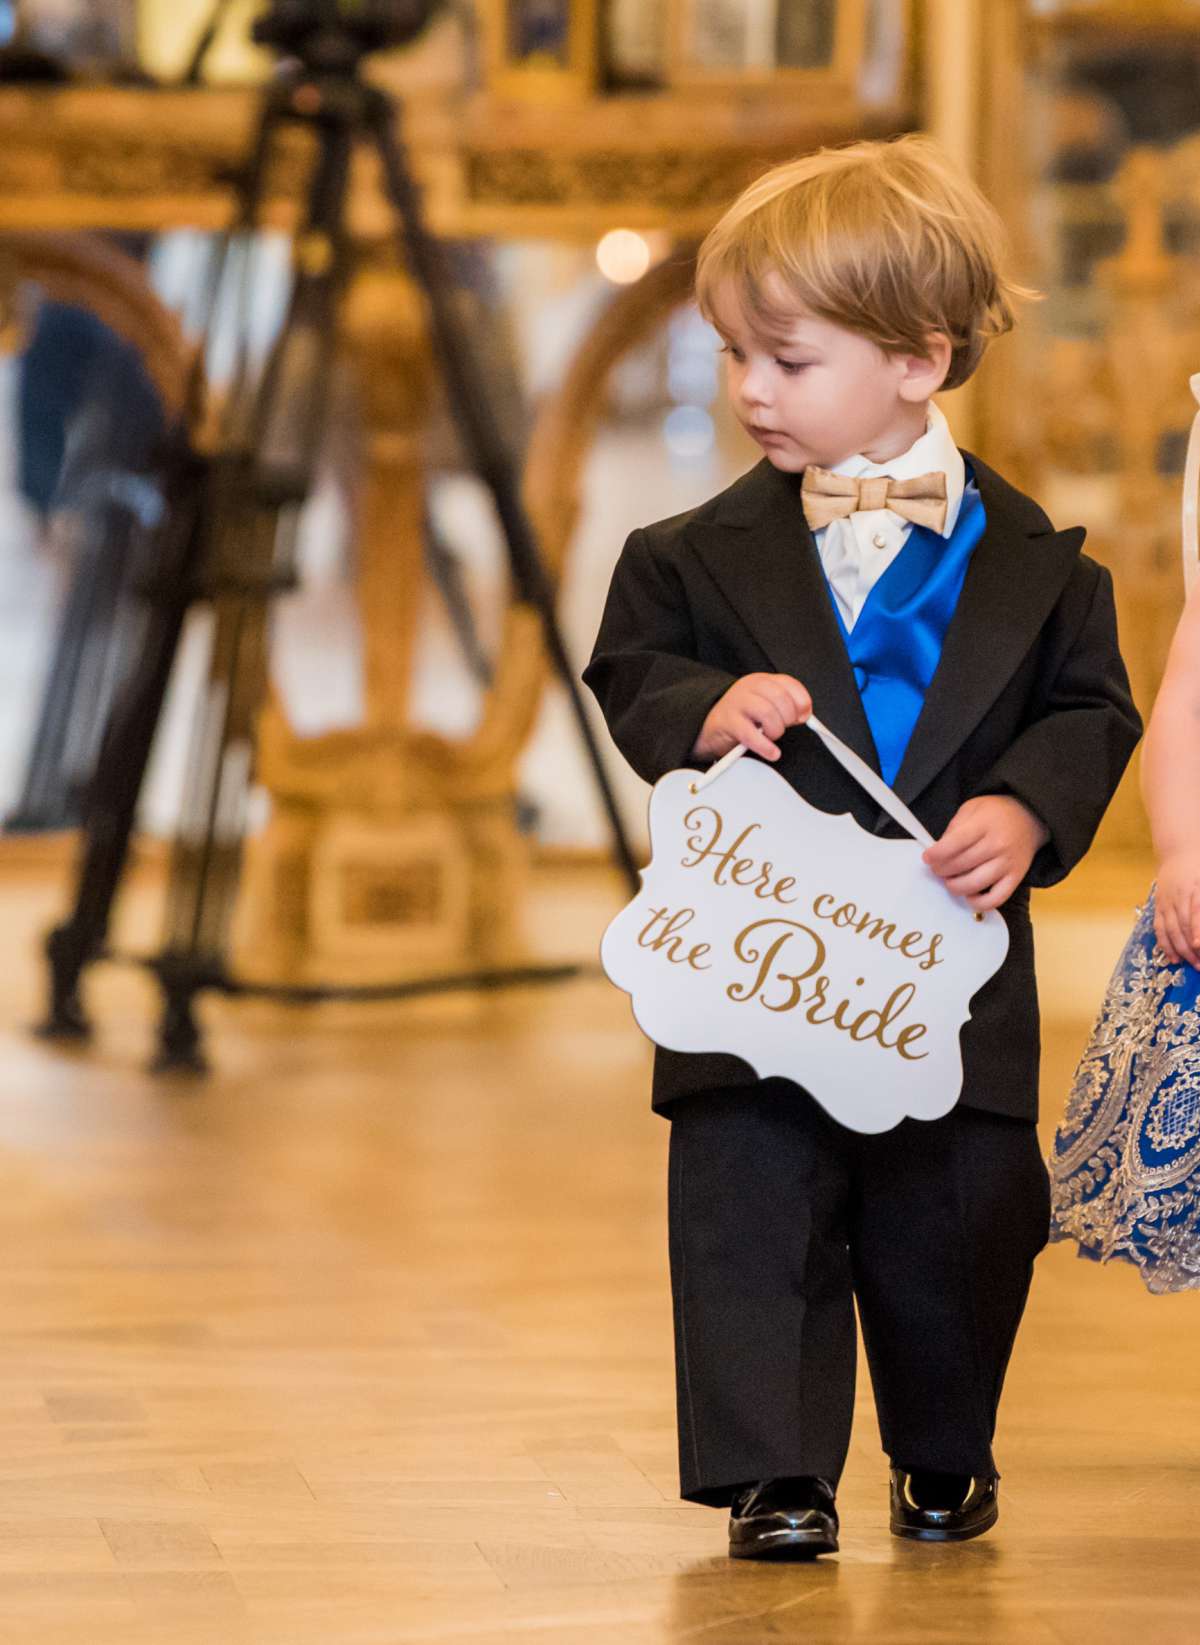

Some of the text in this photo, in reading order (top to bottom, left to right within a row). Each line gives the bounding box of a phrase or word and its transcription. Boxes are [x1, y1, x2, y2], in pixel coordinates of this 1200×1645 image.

[680, 805, 944, 970] Here comes
[637, 907, 929, 1060] the Bride
